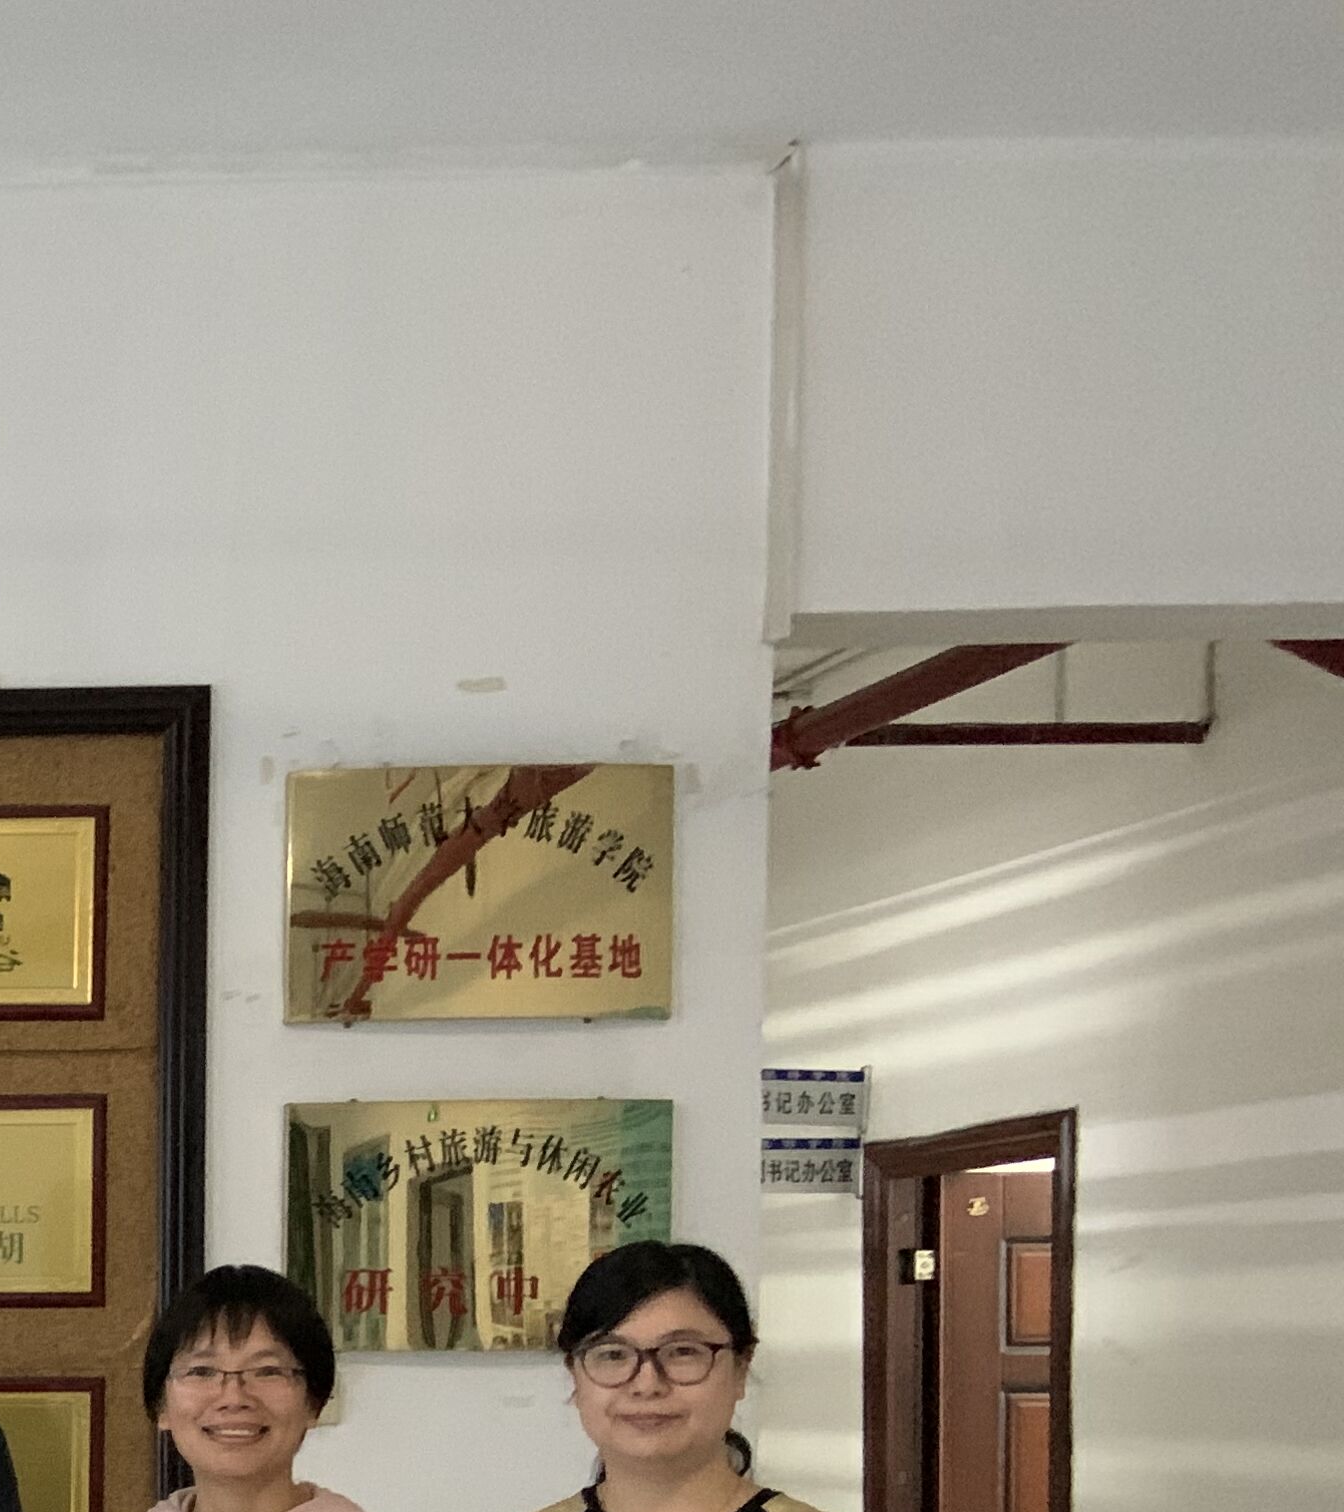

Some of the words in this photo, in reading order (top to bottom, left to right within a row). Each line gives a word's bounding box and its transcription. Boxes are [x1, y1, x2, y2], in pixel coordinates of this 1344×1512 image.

[320, 933, 643, 983] 产学研一体化基地
[761, 1158, 853, 1184] 书记办公室
[342, 1266, 540, 1317] 研究中
